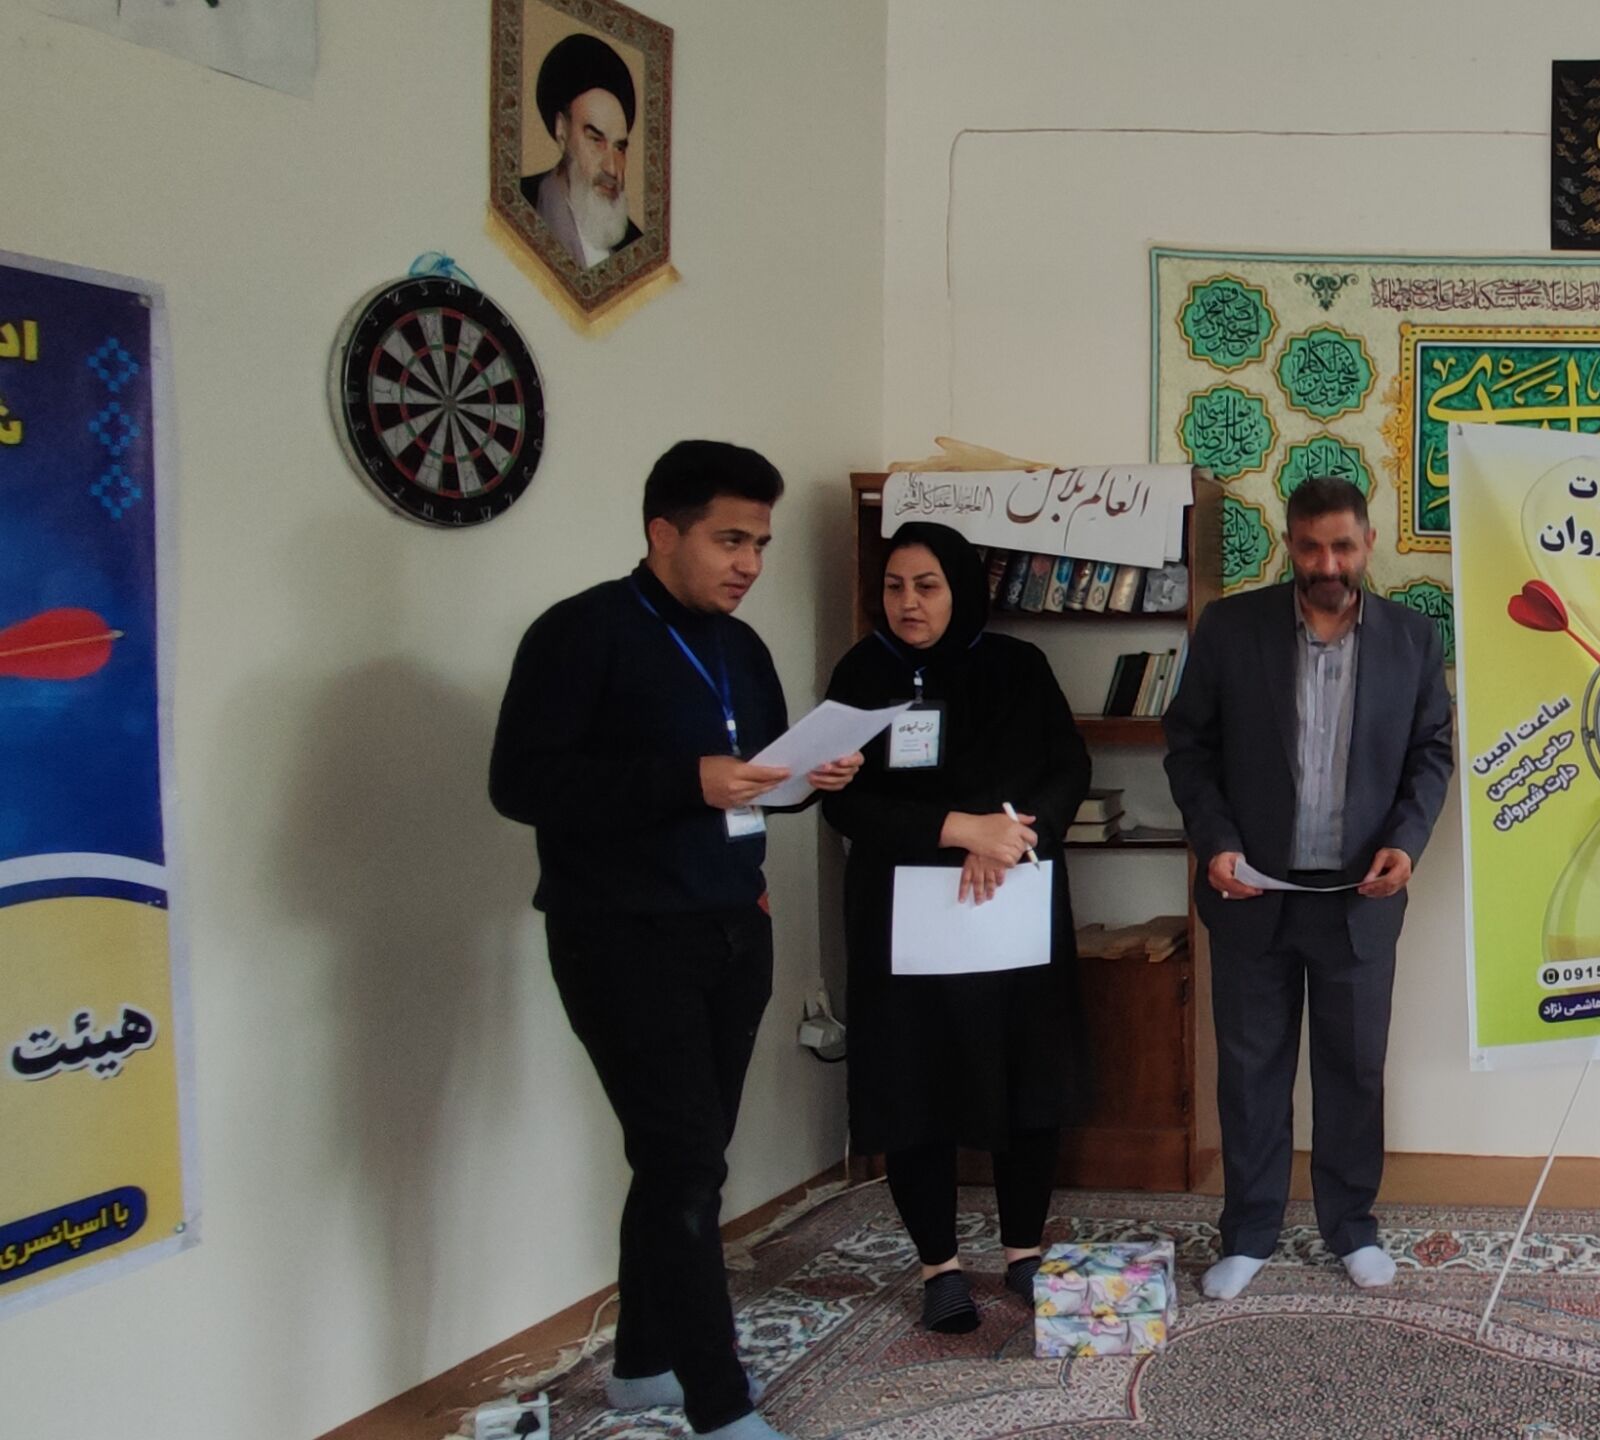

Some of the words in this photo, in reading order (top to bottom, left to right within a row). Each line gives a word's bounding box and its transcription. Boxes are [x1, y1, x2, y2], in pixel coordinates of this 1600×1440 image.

[1517, 697, 1571, 740] ساعت
[1472, 731, 1518, 775] امین
[1535, 730, 1574, 770] حامی
[1488, 756, 1537, 801] انجمن
[1544, 764, 1579, 791] دارت
[1493, 783, 1548, 831] شیروان
[1543, 1002, 1562, 1018] نژاد
[12, 1008, 153, 1076] هیئت
[114, 1202, 130, 1227] با
[0, 1208, 108, 1271] اسپانسری
